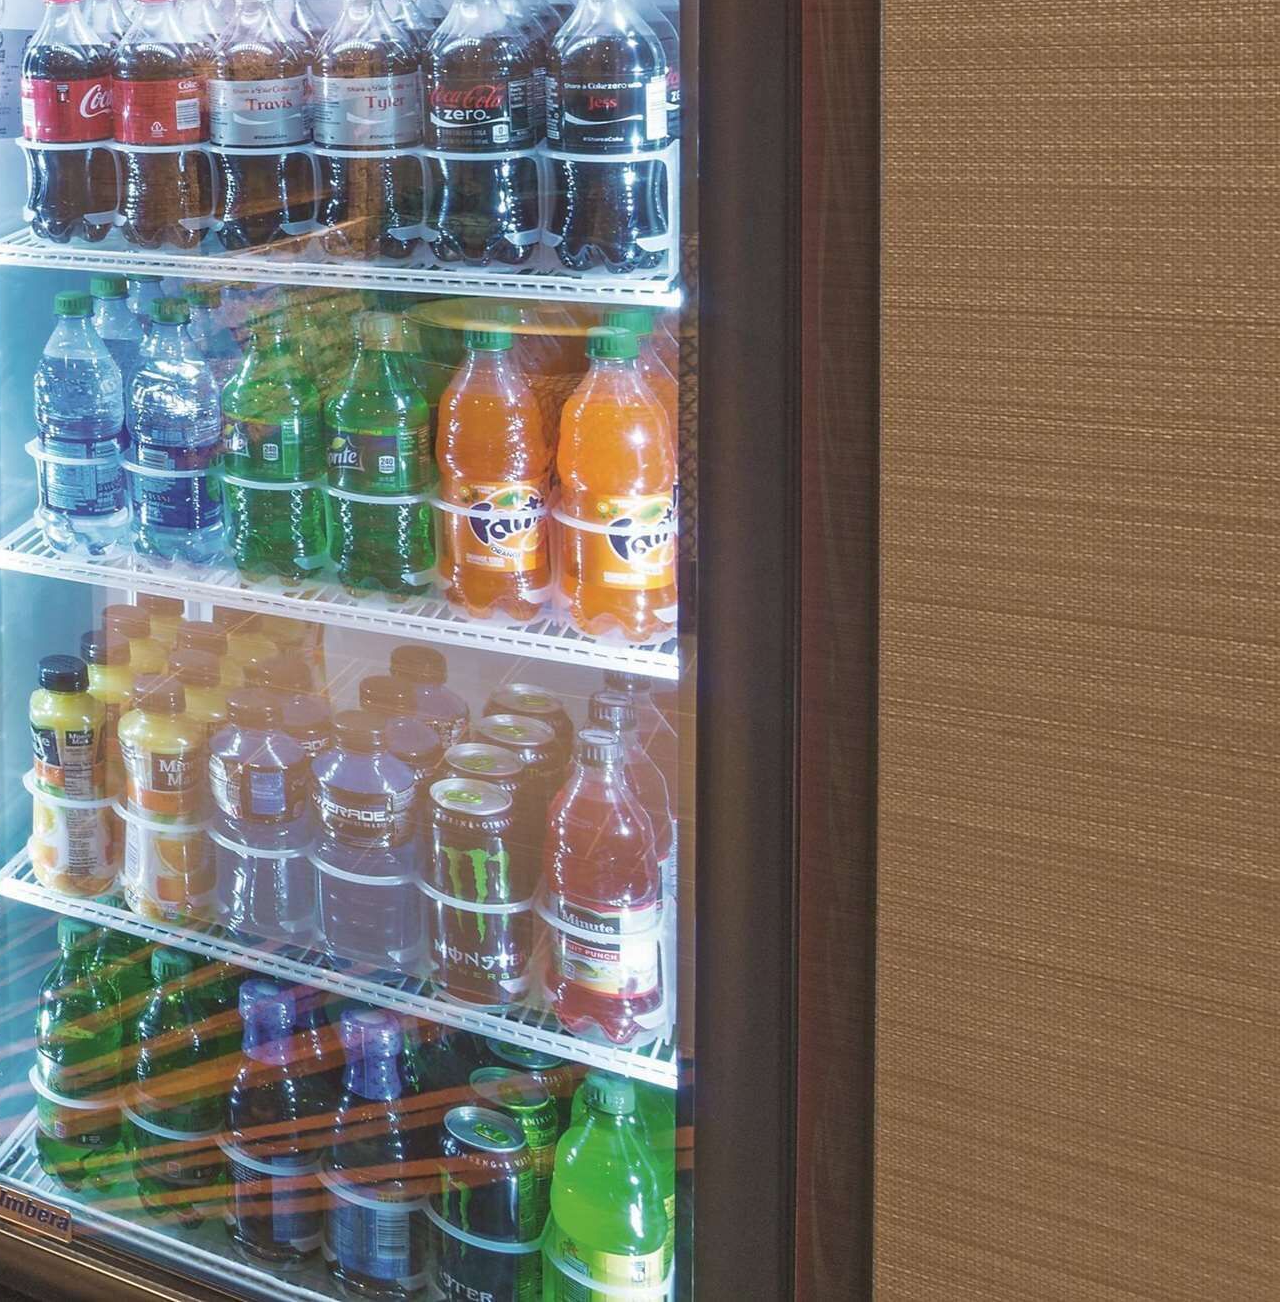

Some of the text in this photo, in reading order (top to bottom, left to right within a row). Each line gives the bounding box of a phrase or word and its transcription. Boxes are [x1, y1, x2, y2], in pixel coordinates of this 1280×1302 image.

[246, 97, 293, 111] Travis
[366, 96, 404, 111] Tyler
[589, 96, 618, 110] Jess
[443, 109, 487, 121] zero
[379, 457, 393, 465] 240
[561, 911, 615, 935] Minute
[584, 949, 619, 961] PUNCH
